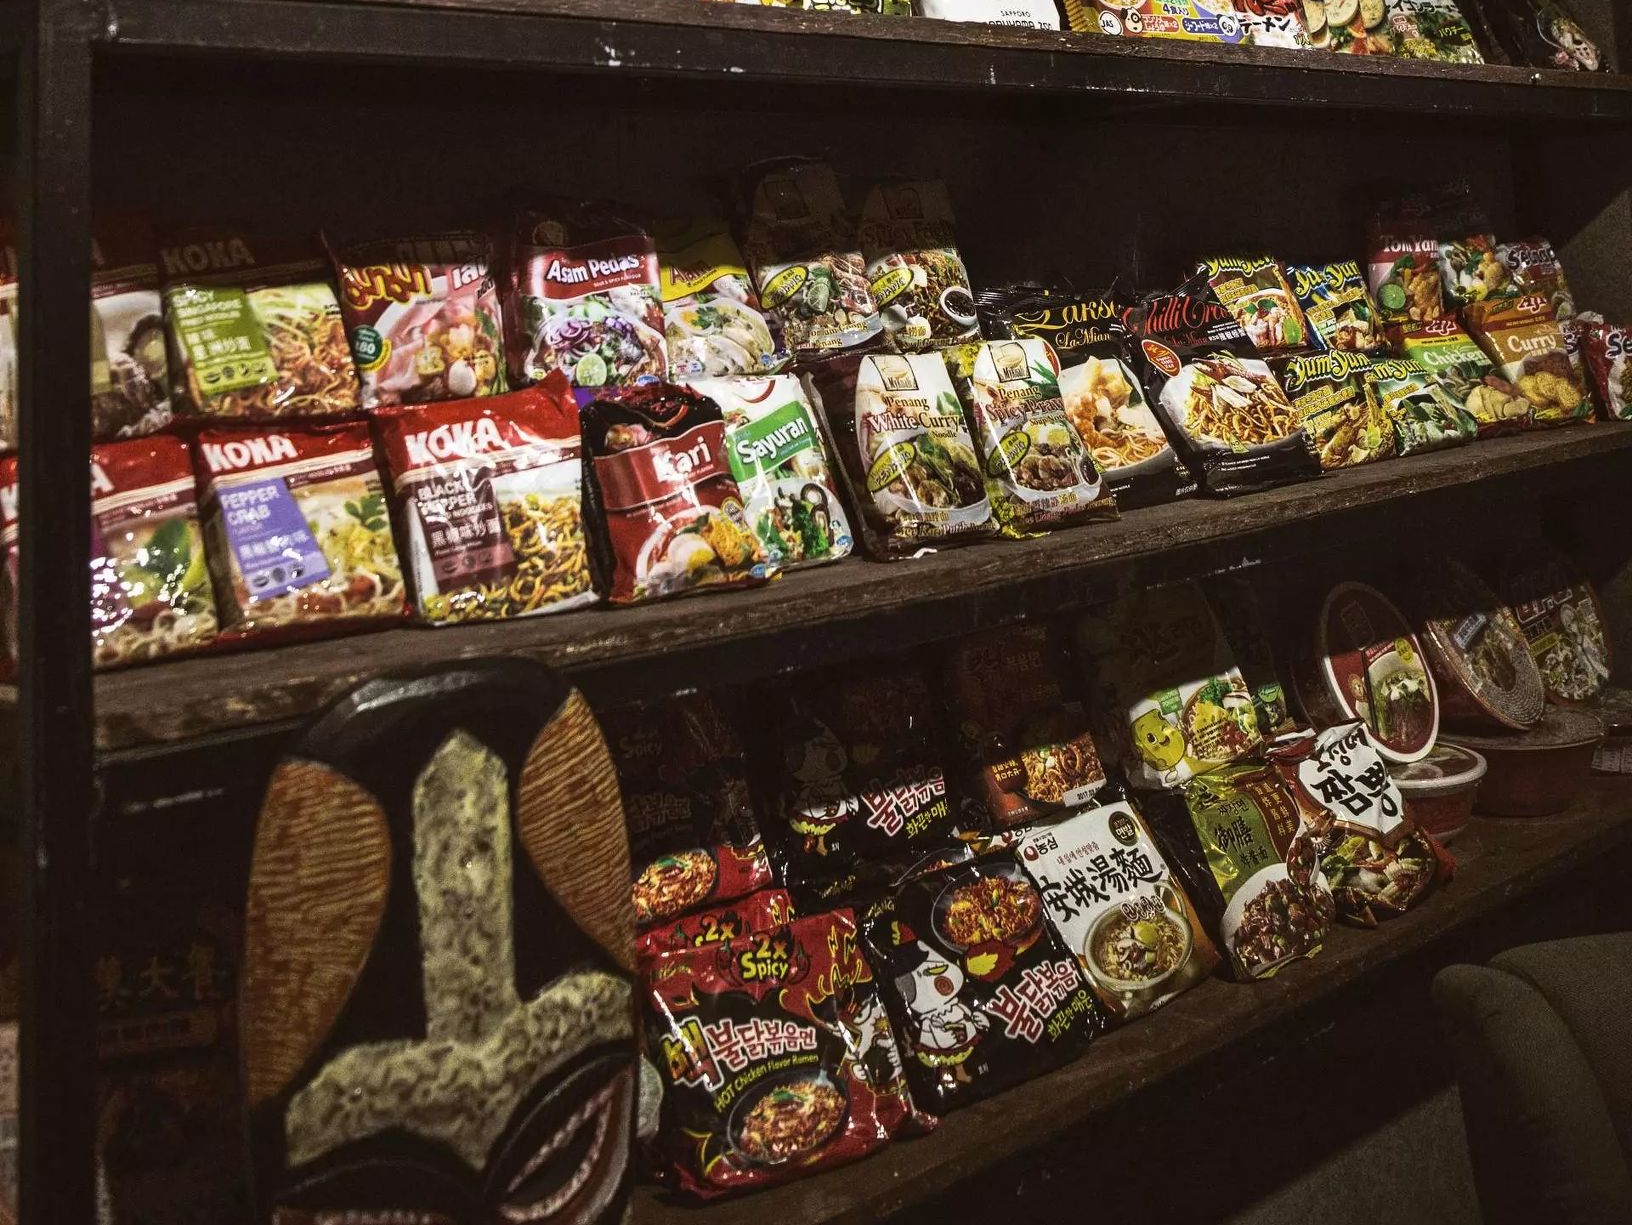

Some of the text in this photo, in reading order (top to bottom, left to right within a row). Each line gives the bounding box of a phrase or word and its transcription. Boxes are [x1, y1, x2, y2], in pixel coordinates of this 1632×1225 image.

[1101, 19, 1114, 28] JAS
[546, 259, 590, 284] Asam
[587, 254, 640, 279] Pedas
[1507, 334, 1557, 353] Curry
[884, 395, 930, 411] Penang
[998, 385, 1042, 402] Penang
[867, 410, 960, 433] White Curry
[200, 434, 299, 473] KOKA
[404, 417, 512, 466] KOKA
[736, 417, 809, 464] Sayuran
[651, 436, 712, 483] Kari
[220, 485, 280, 510] PEPPER
[752, 933, 789, 960] 2x
[742, 953, 789, 981] Spicy
[705, 1016, 818, 1072] 불닭볶음면
[713, 1086, 736, 1113] HOT
[734, 1066, 767, 1092] Chicken
[791, 1053, 820, 1065] Ramen
